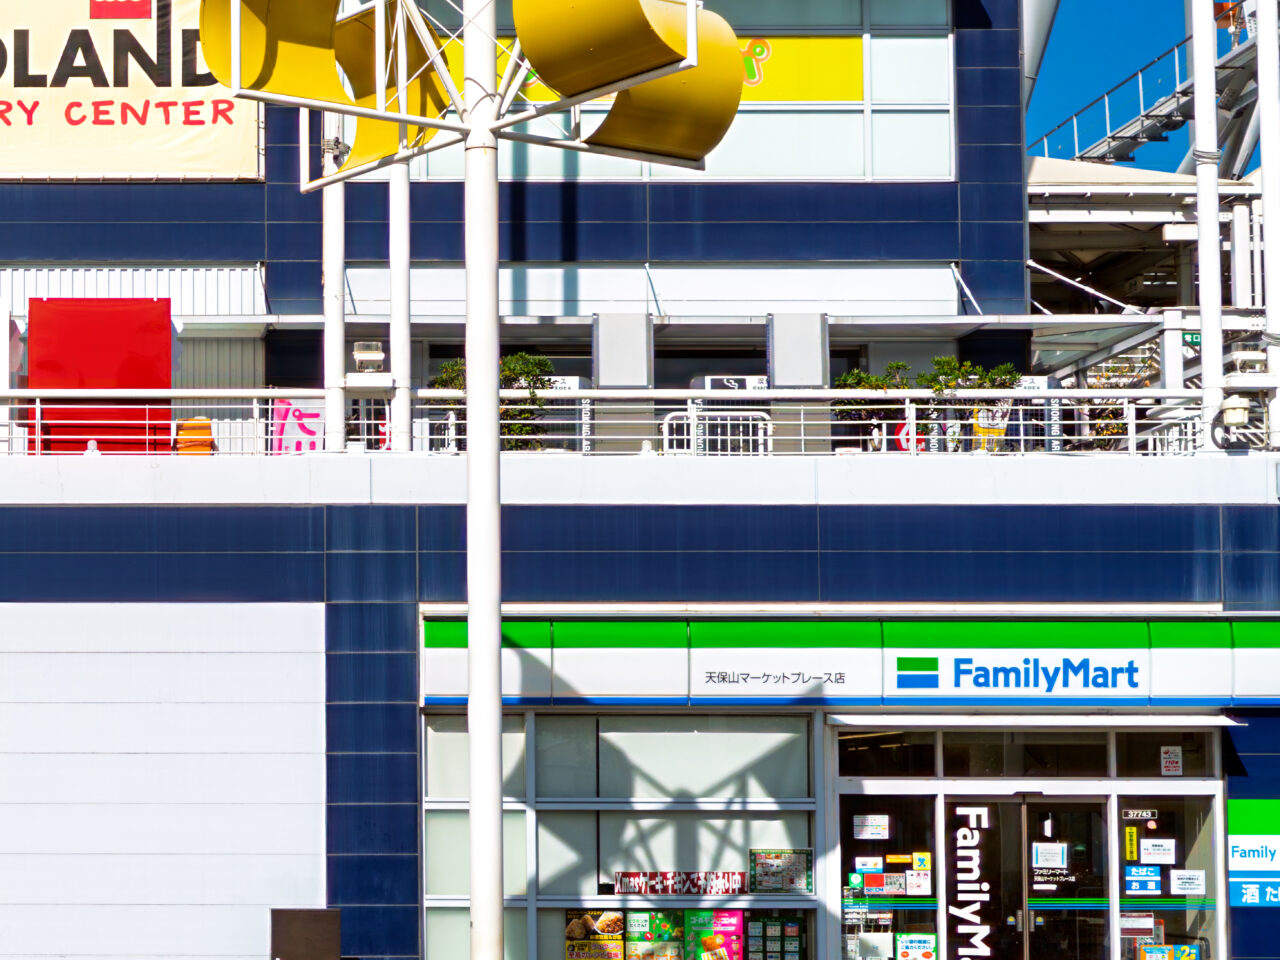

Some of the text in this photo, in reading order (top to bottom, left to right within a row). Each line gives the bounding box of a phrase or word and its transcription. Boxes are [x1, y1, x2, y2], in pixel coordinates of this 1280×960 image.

[64, 98, 235, 127] CENTER
[1051, 398, 1060, 436] SMOKNG
[705, 671, 846, 685] 天保山マーケットプレース店
[953, 657, 1139, 693] FamilyMart
[1231, 845, 1277, 862] Family
[948, 806, 991, 960] FamilyM
[1131, 867, 1155, 876] たばこ
[1265, 886, 1280, 902] た
